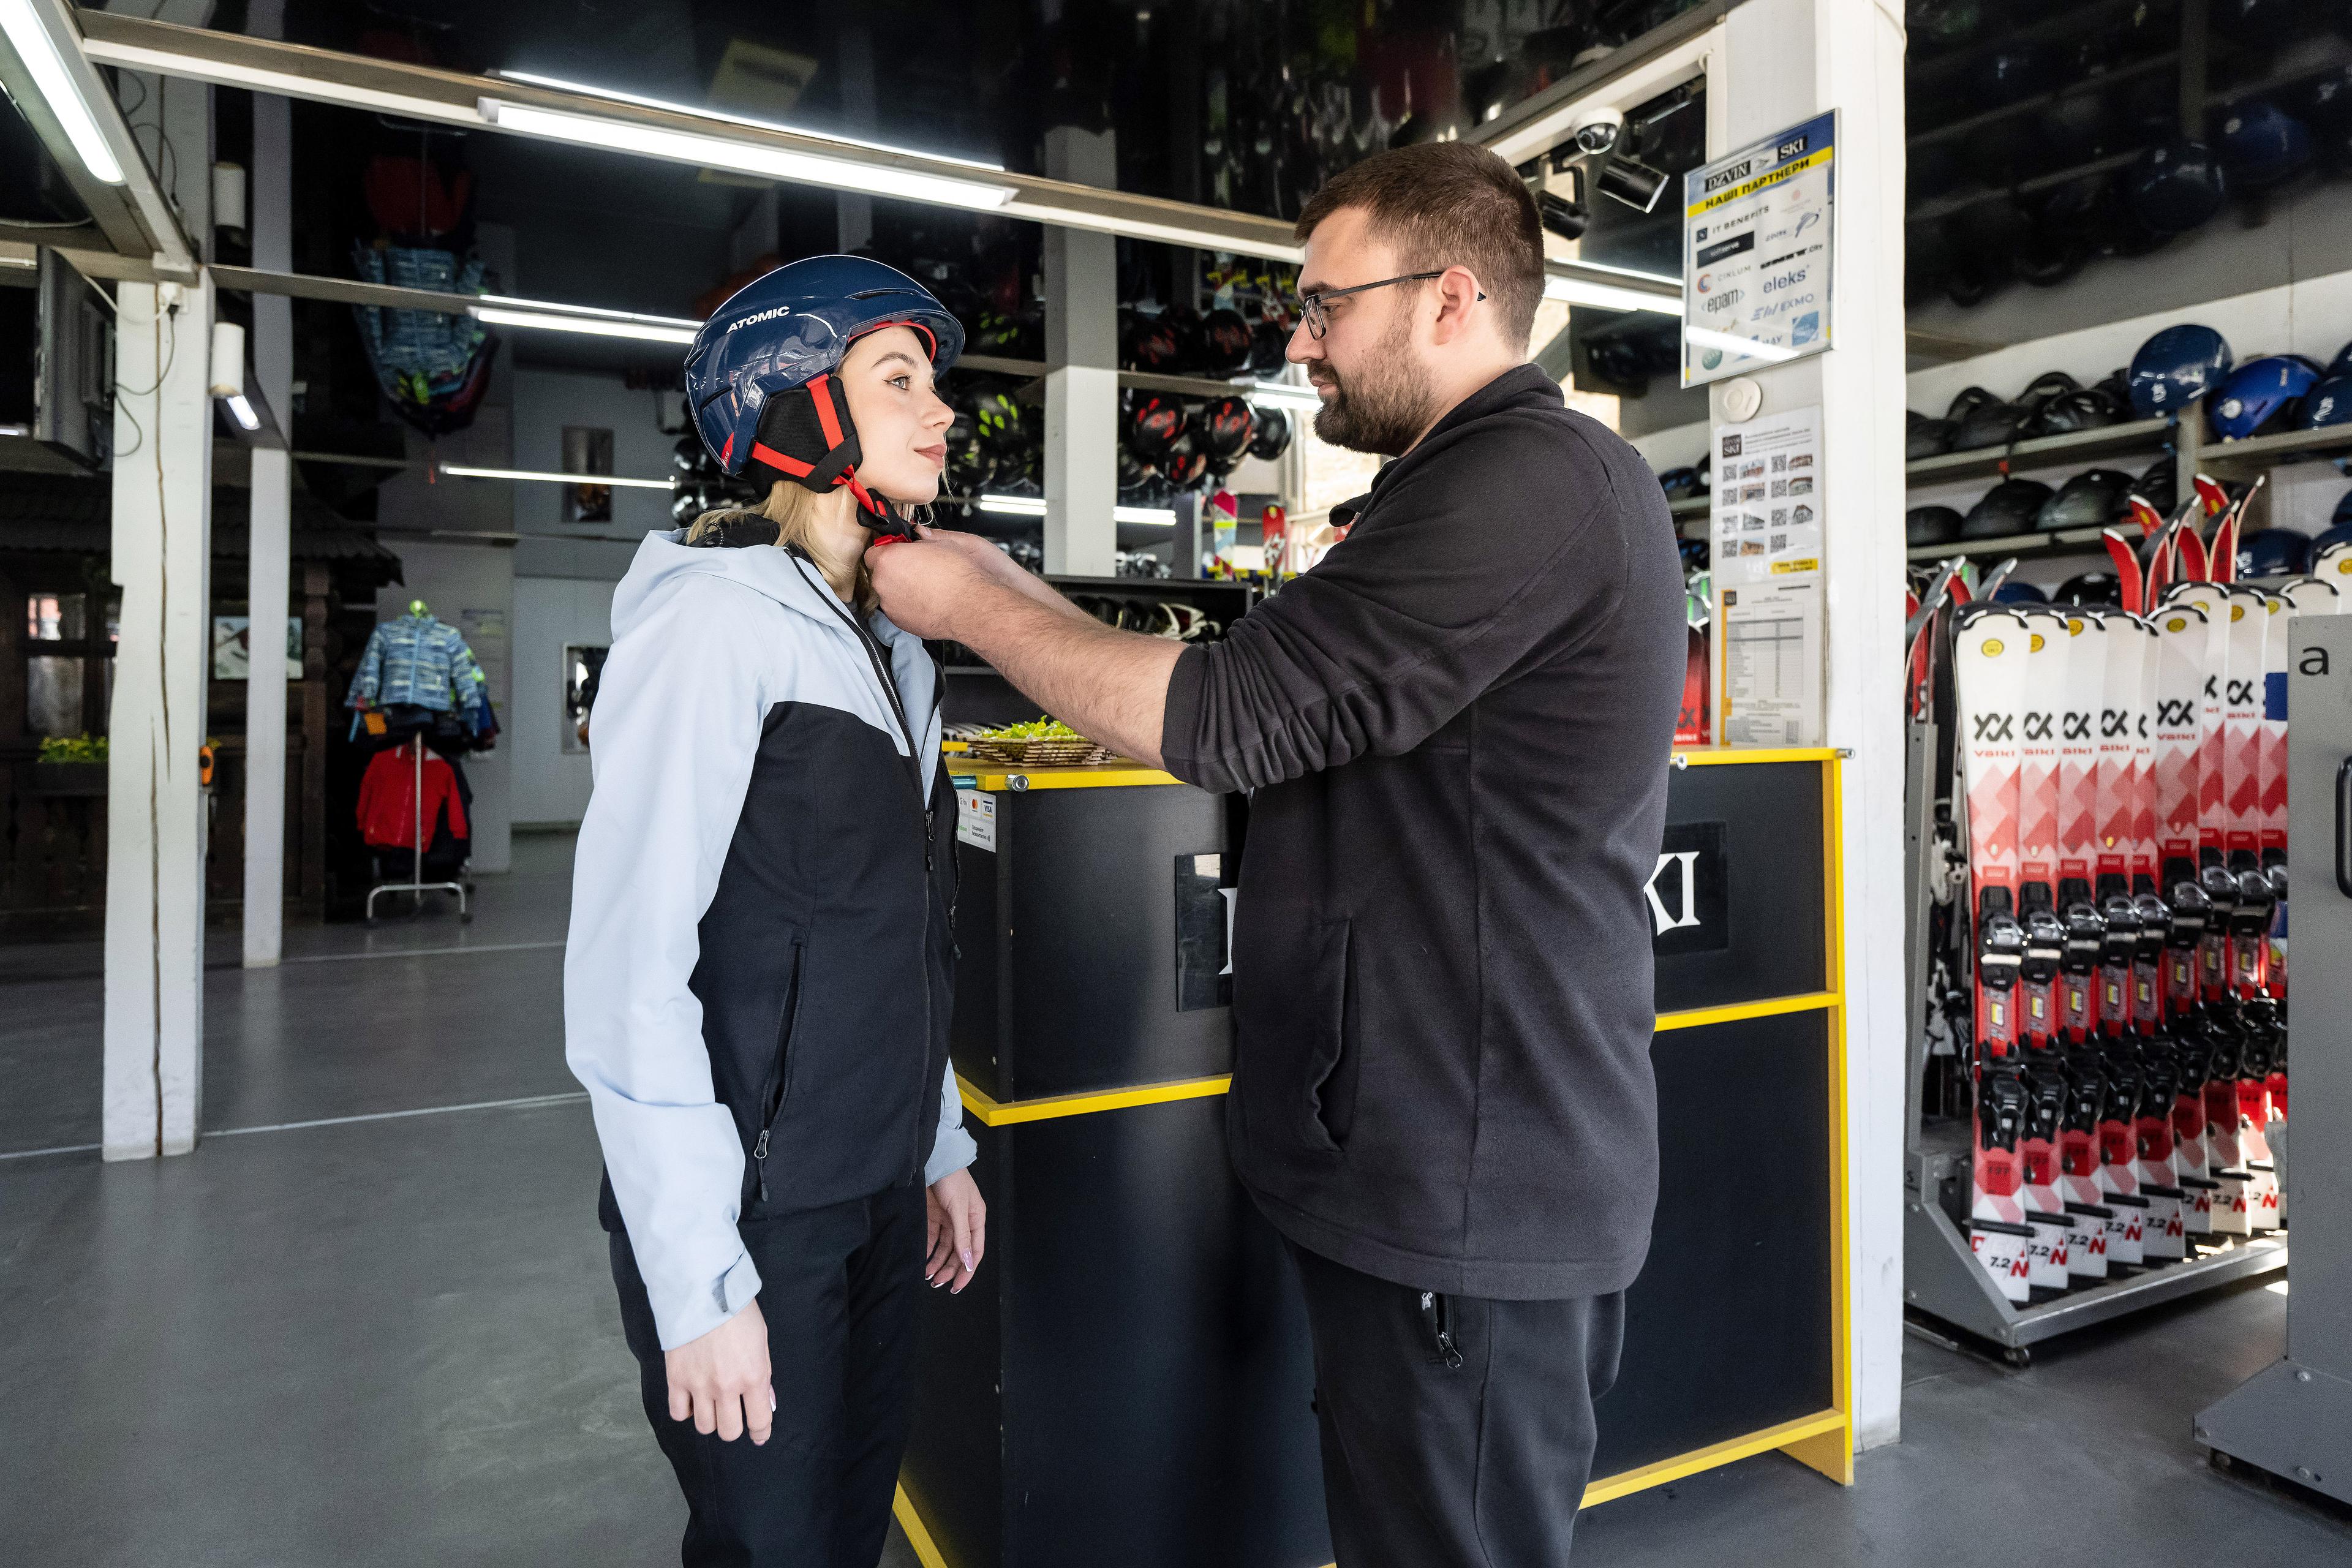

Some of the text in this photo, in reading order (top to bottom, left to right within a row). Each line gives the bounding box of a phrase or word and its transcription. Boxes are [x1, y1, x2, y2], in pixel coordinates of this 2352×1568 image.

[1780, 138, 1804, 159] SKI
[1706, 158, 1809, 209] НАШІ ПАРТНЕРИ
[1713, 224, 1721, 235] IT
[1724, 205, 1770, 230] BENEFITS
[1763, 269, 1806, 294] eleks
[726, 306, 790, 334] ATOMIC
[2299, 647, 2329, 676] a
[984, 805, 992, 813] VISA
[2195, 1196, 2211, 1213] N
[2233, 1197, 2246, 1213] N
[2262, 1193, 2278, 1209] N
[2105, 1221, 2143, 1242] 7.2 N
[2166, 1220, 2184, 1237] N
[2068, 1234, 2106, 1255] 7.2 N
[2029, 1245, 2068, 1266] 7.2 N
[1990, 1256, 2029, 1278] 7.2 N
